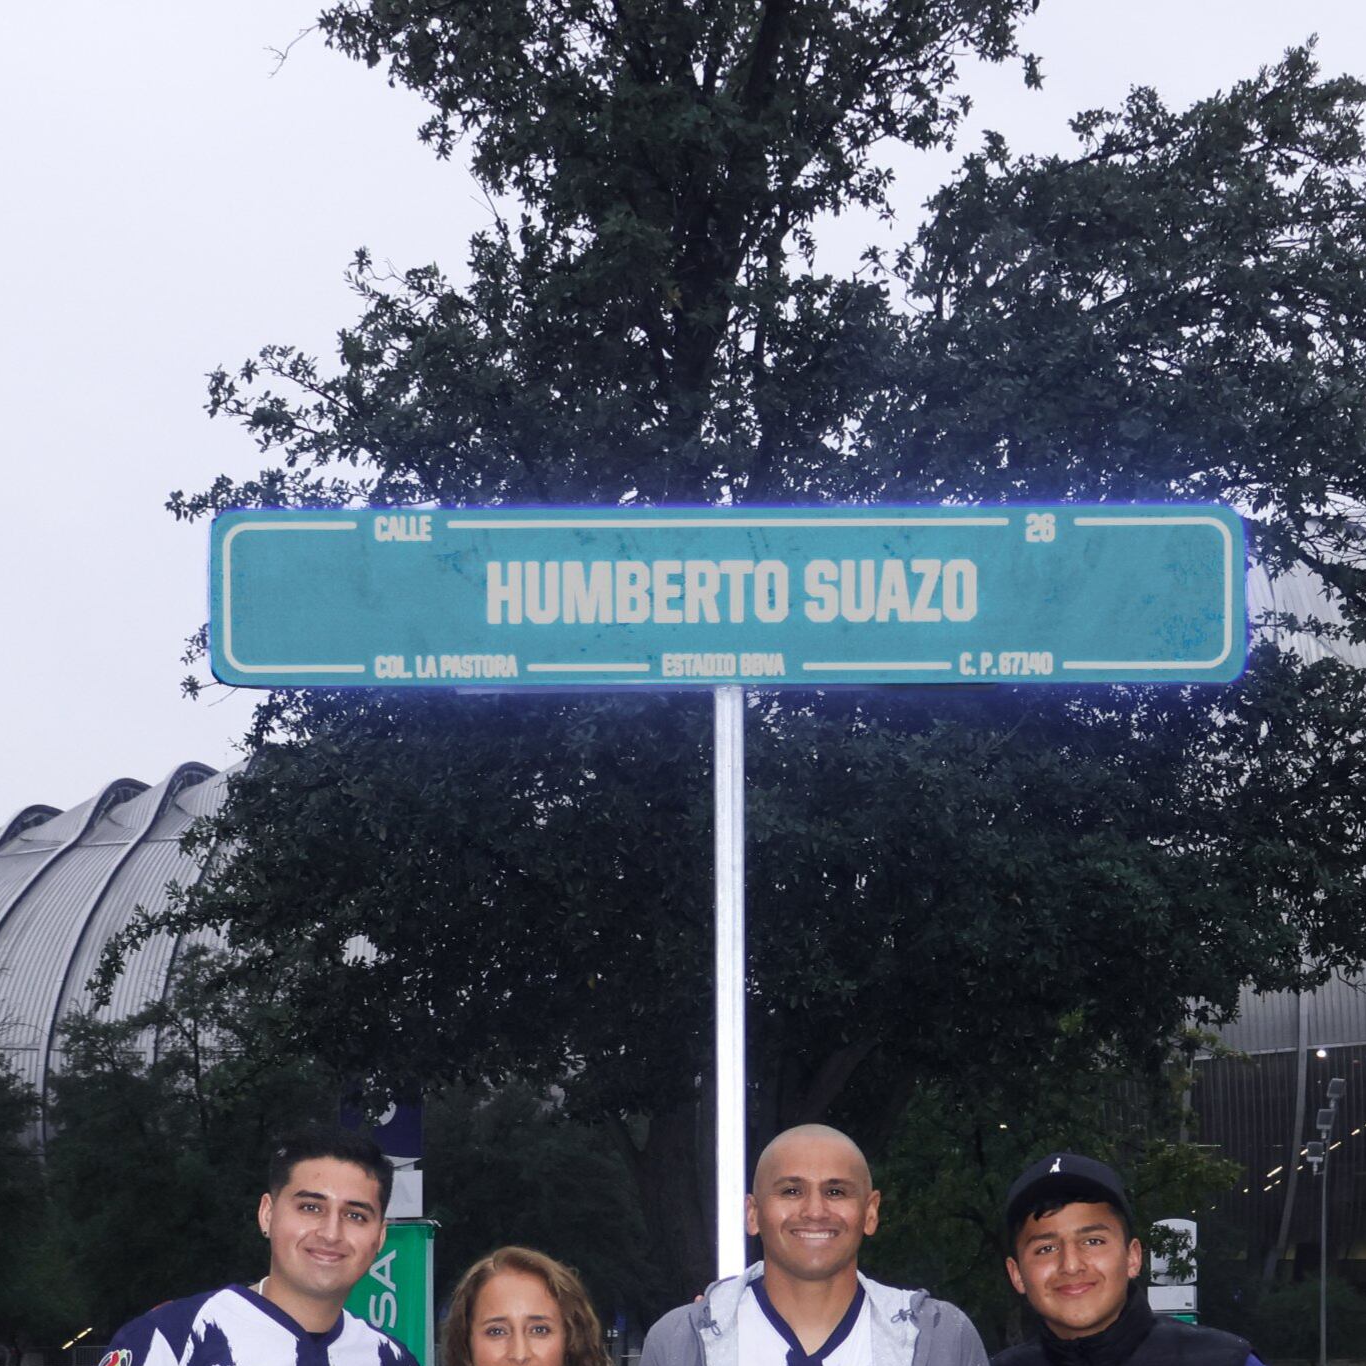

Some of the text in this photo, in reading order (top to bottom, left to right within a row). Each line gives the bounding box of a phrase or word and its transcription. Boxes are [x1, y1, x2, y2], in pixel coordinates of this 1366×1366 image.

[374, 515, 433, 541] CALLE
[1025, 513, 1056, 542] 26
[486, 559, 978, 624] HUMBERTO SUAZO
[374, 654, 519, 679] COL. LA PASTORA
[661, 652, 786, 677] ESTADIO BBVA
